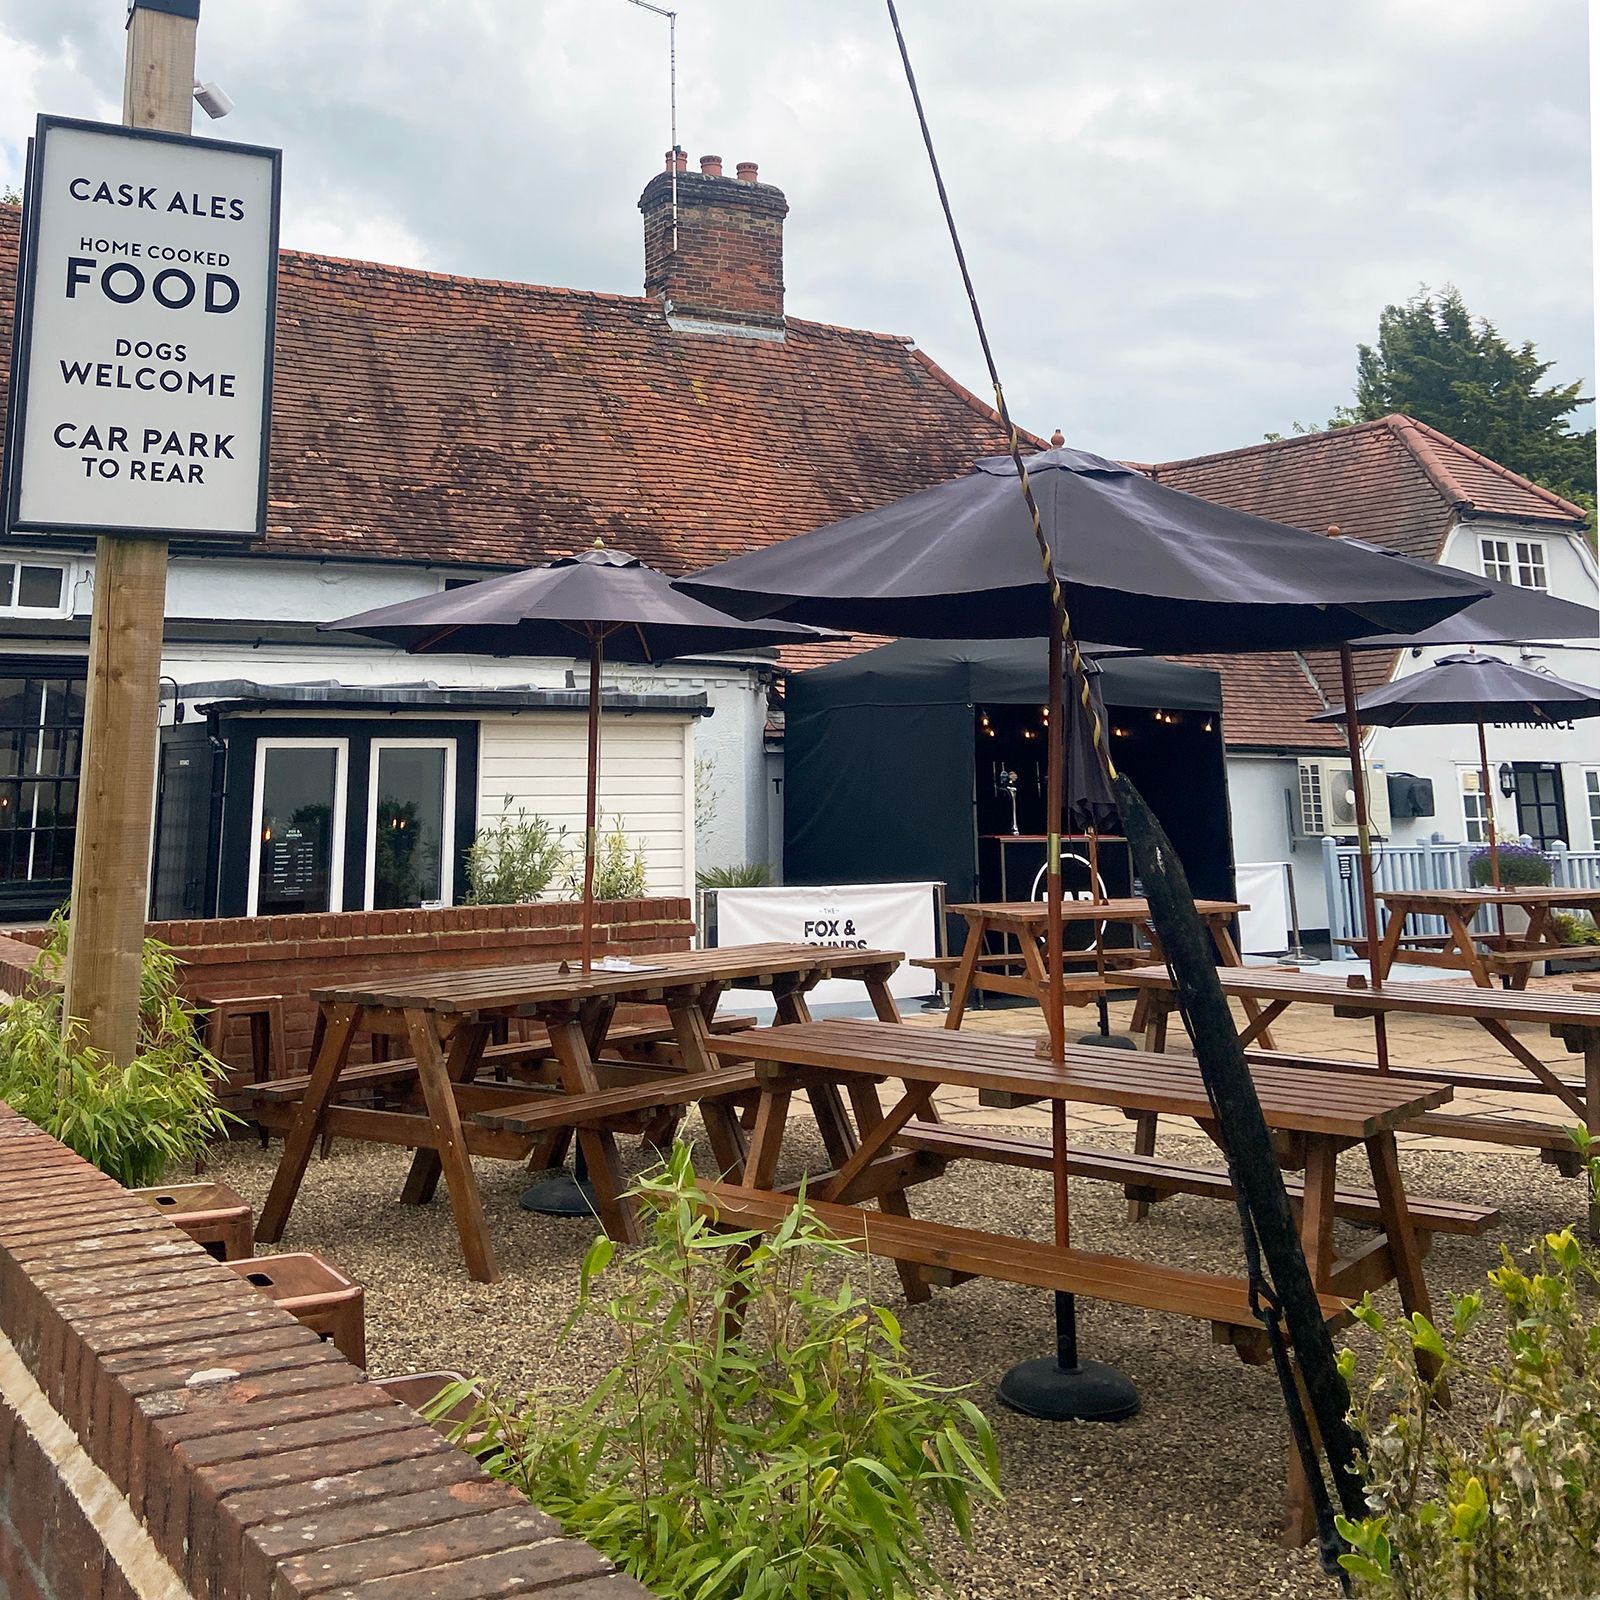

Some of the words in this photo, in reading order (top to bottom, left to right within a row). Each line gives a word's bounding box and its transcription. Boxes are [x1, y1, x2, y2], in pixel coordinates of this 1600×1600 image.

[69, 177, 158, 211] CASK
[166, 191, 245, 221] ALES
[80, 236, 142, 258] HOME
[147, 245, 230, 267] COOKED
[65, 256, 240, 314] FOOD
[115, 338, 187, 363] DOGS
[59, 359, 236, 398] WELCOME
[53, 422, 130, 453] CAR
[142, 428, 235, 460] PARK
[81, 456, 120, 479] TO
[129, 460, 205, 485] REAR
[804, 919, 840, 938] FOX
[843, 919, 857, 936] &
